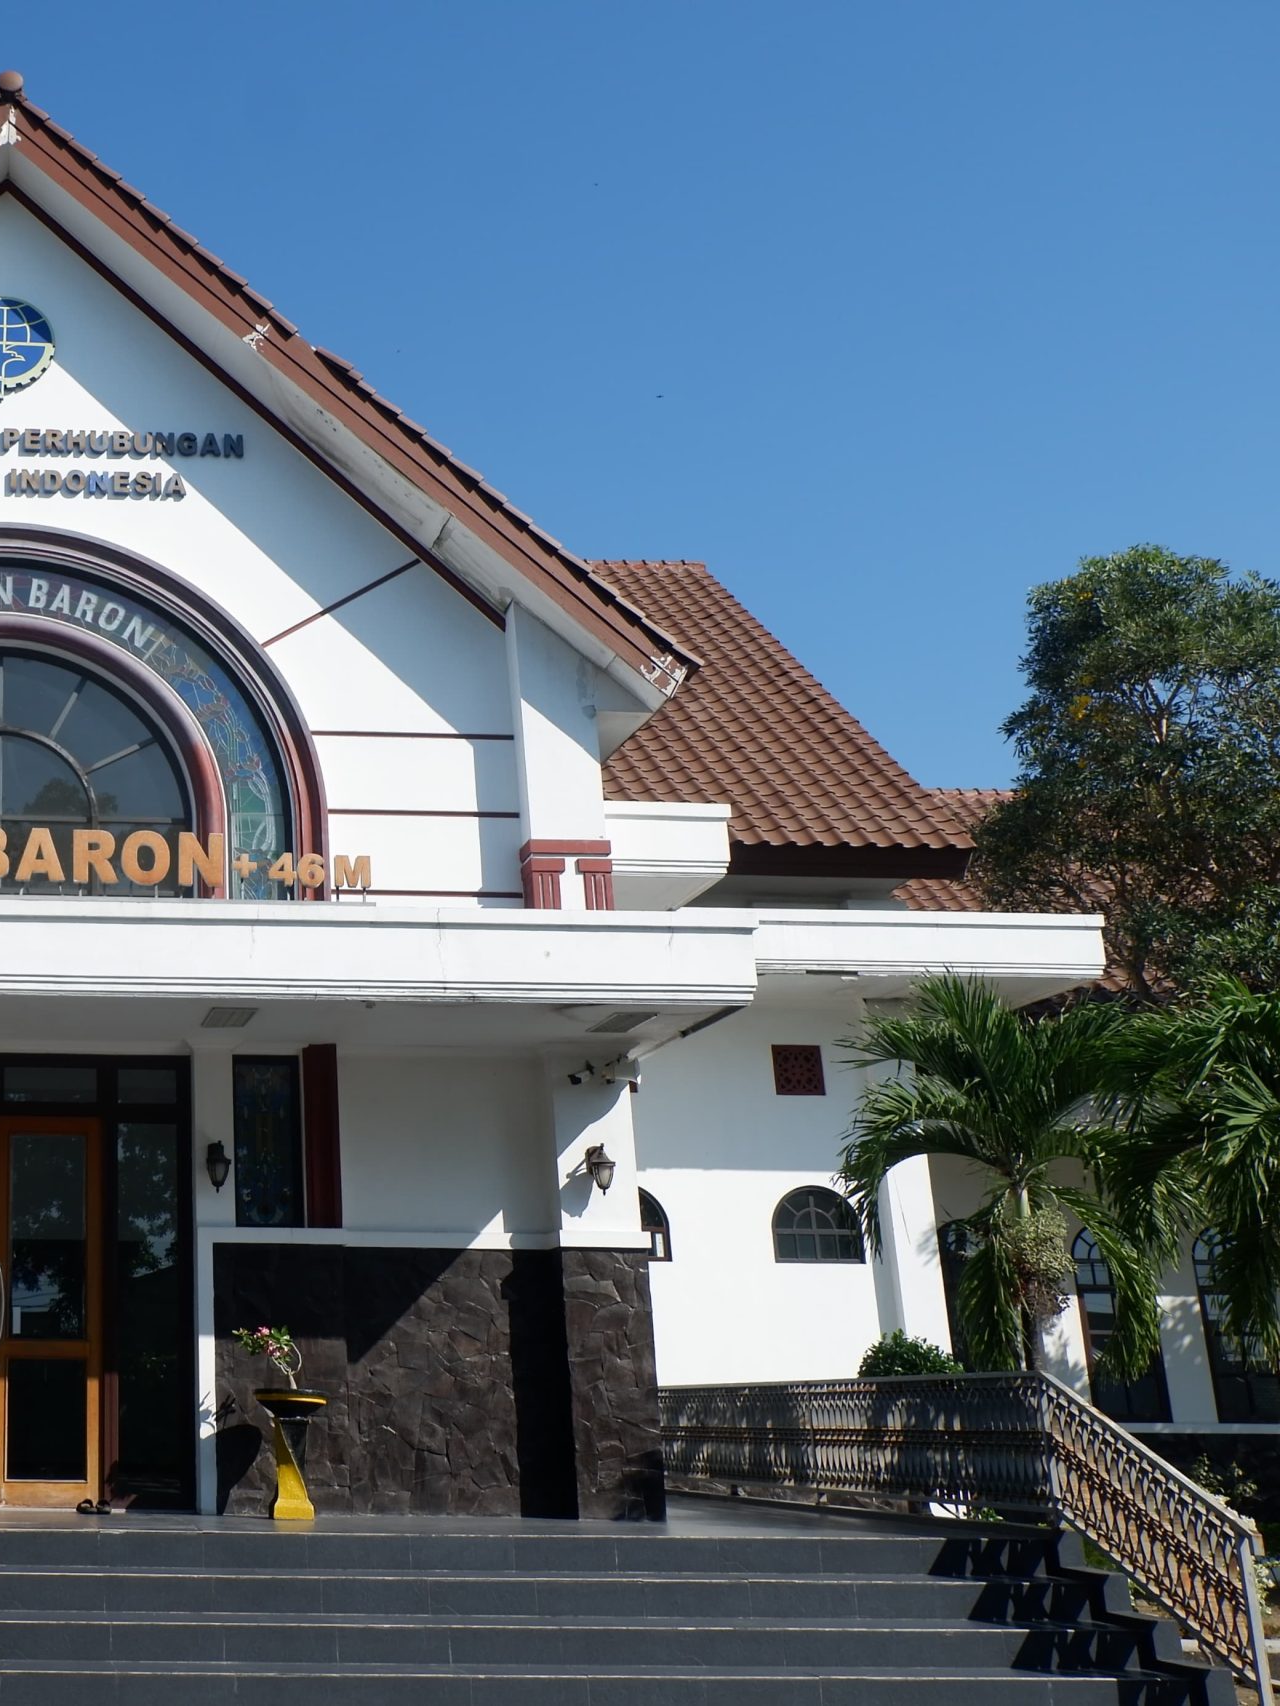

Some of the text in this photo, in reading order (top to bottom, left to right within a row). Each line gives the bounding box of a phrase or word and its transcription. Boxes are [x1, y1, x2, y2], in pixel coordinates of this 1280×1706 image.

[2, 428, 245, 459] PERHUBUNGAN
[9, 468, 187, 498] INDONESIA
[28, 577, 155, 648] BARON
